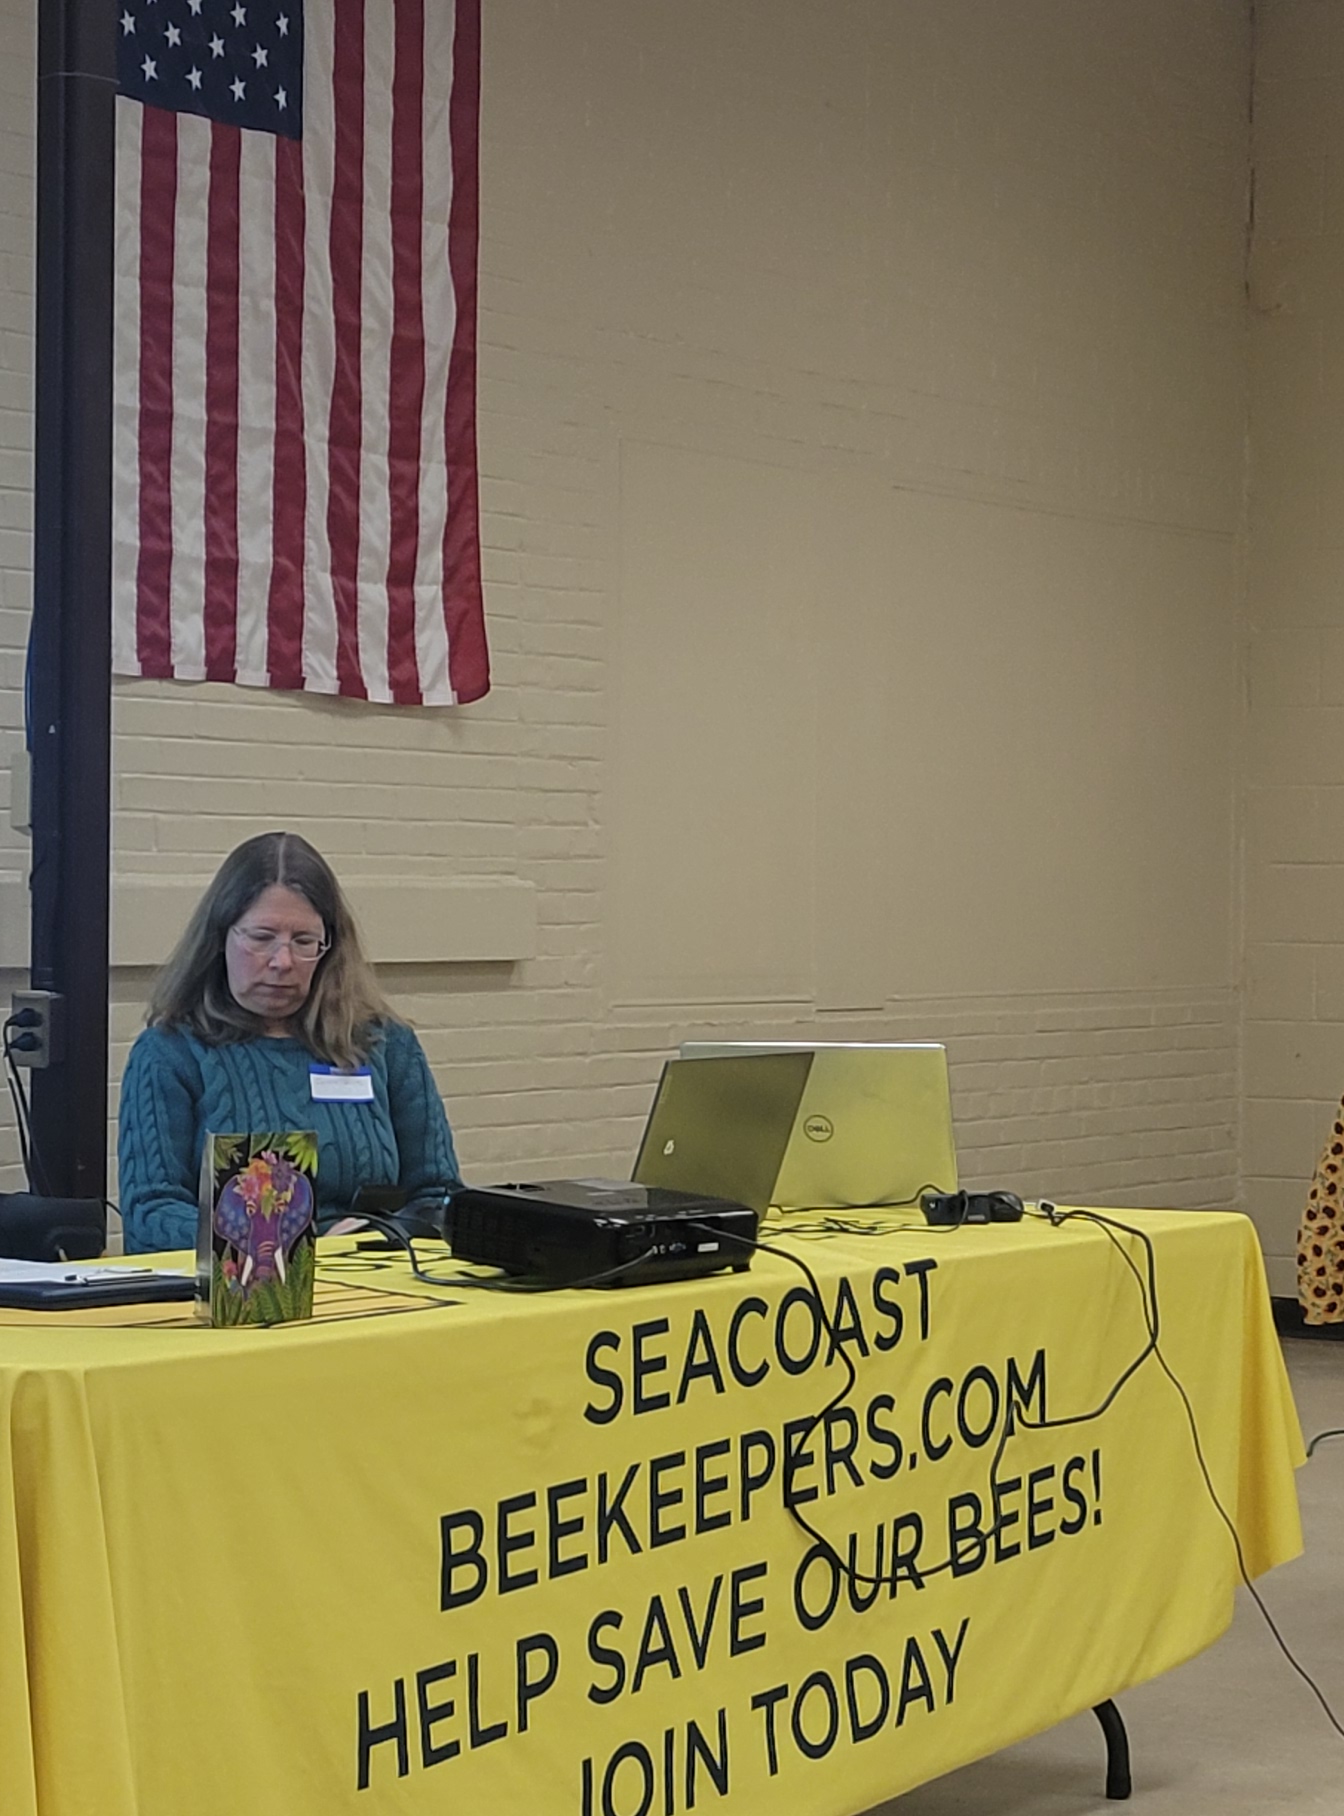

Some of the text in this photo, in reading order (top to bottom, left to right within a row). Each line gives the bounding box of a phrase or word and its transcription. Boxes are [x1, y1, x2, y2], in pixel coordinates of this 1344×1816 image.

[583, 1259, 937, 1426] SEACOAST
[440, 1348, 1047, 1612] BEEKEEPERS.COM
[356, 1449, 1102, 1791] HELP SAVE OUR BEES!
[750, 1617, 971, 1777] TODAY
